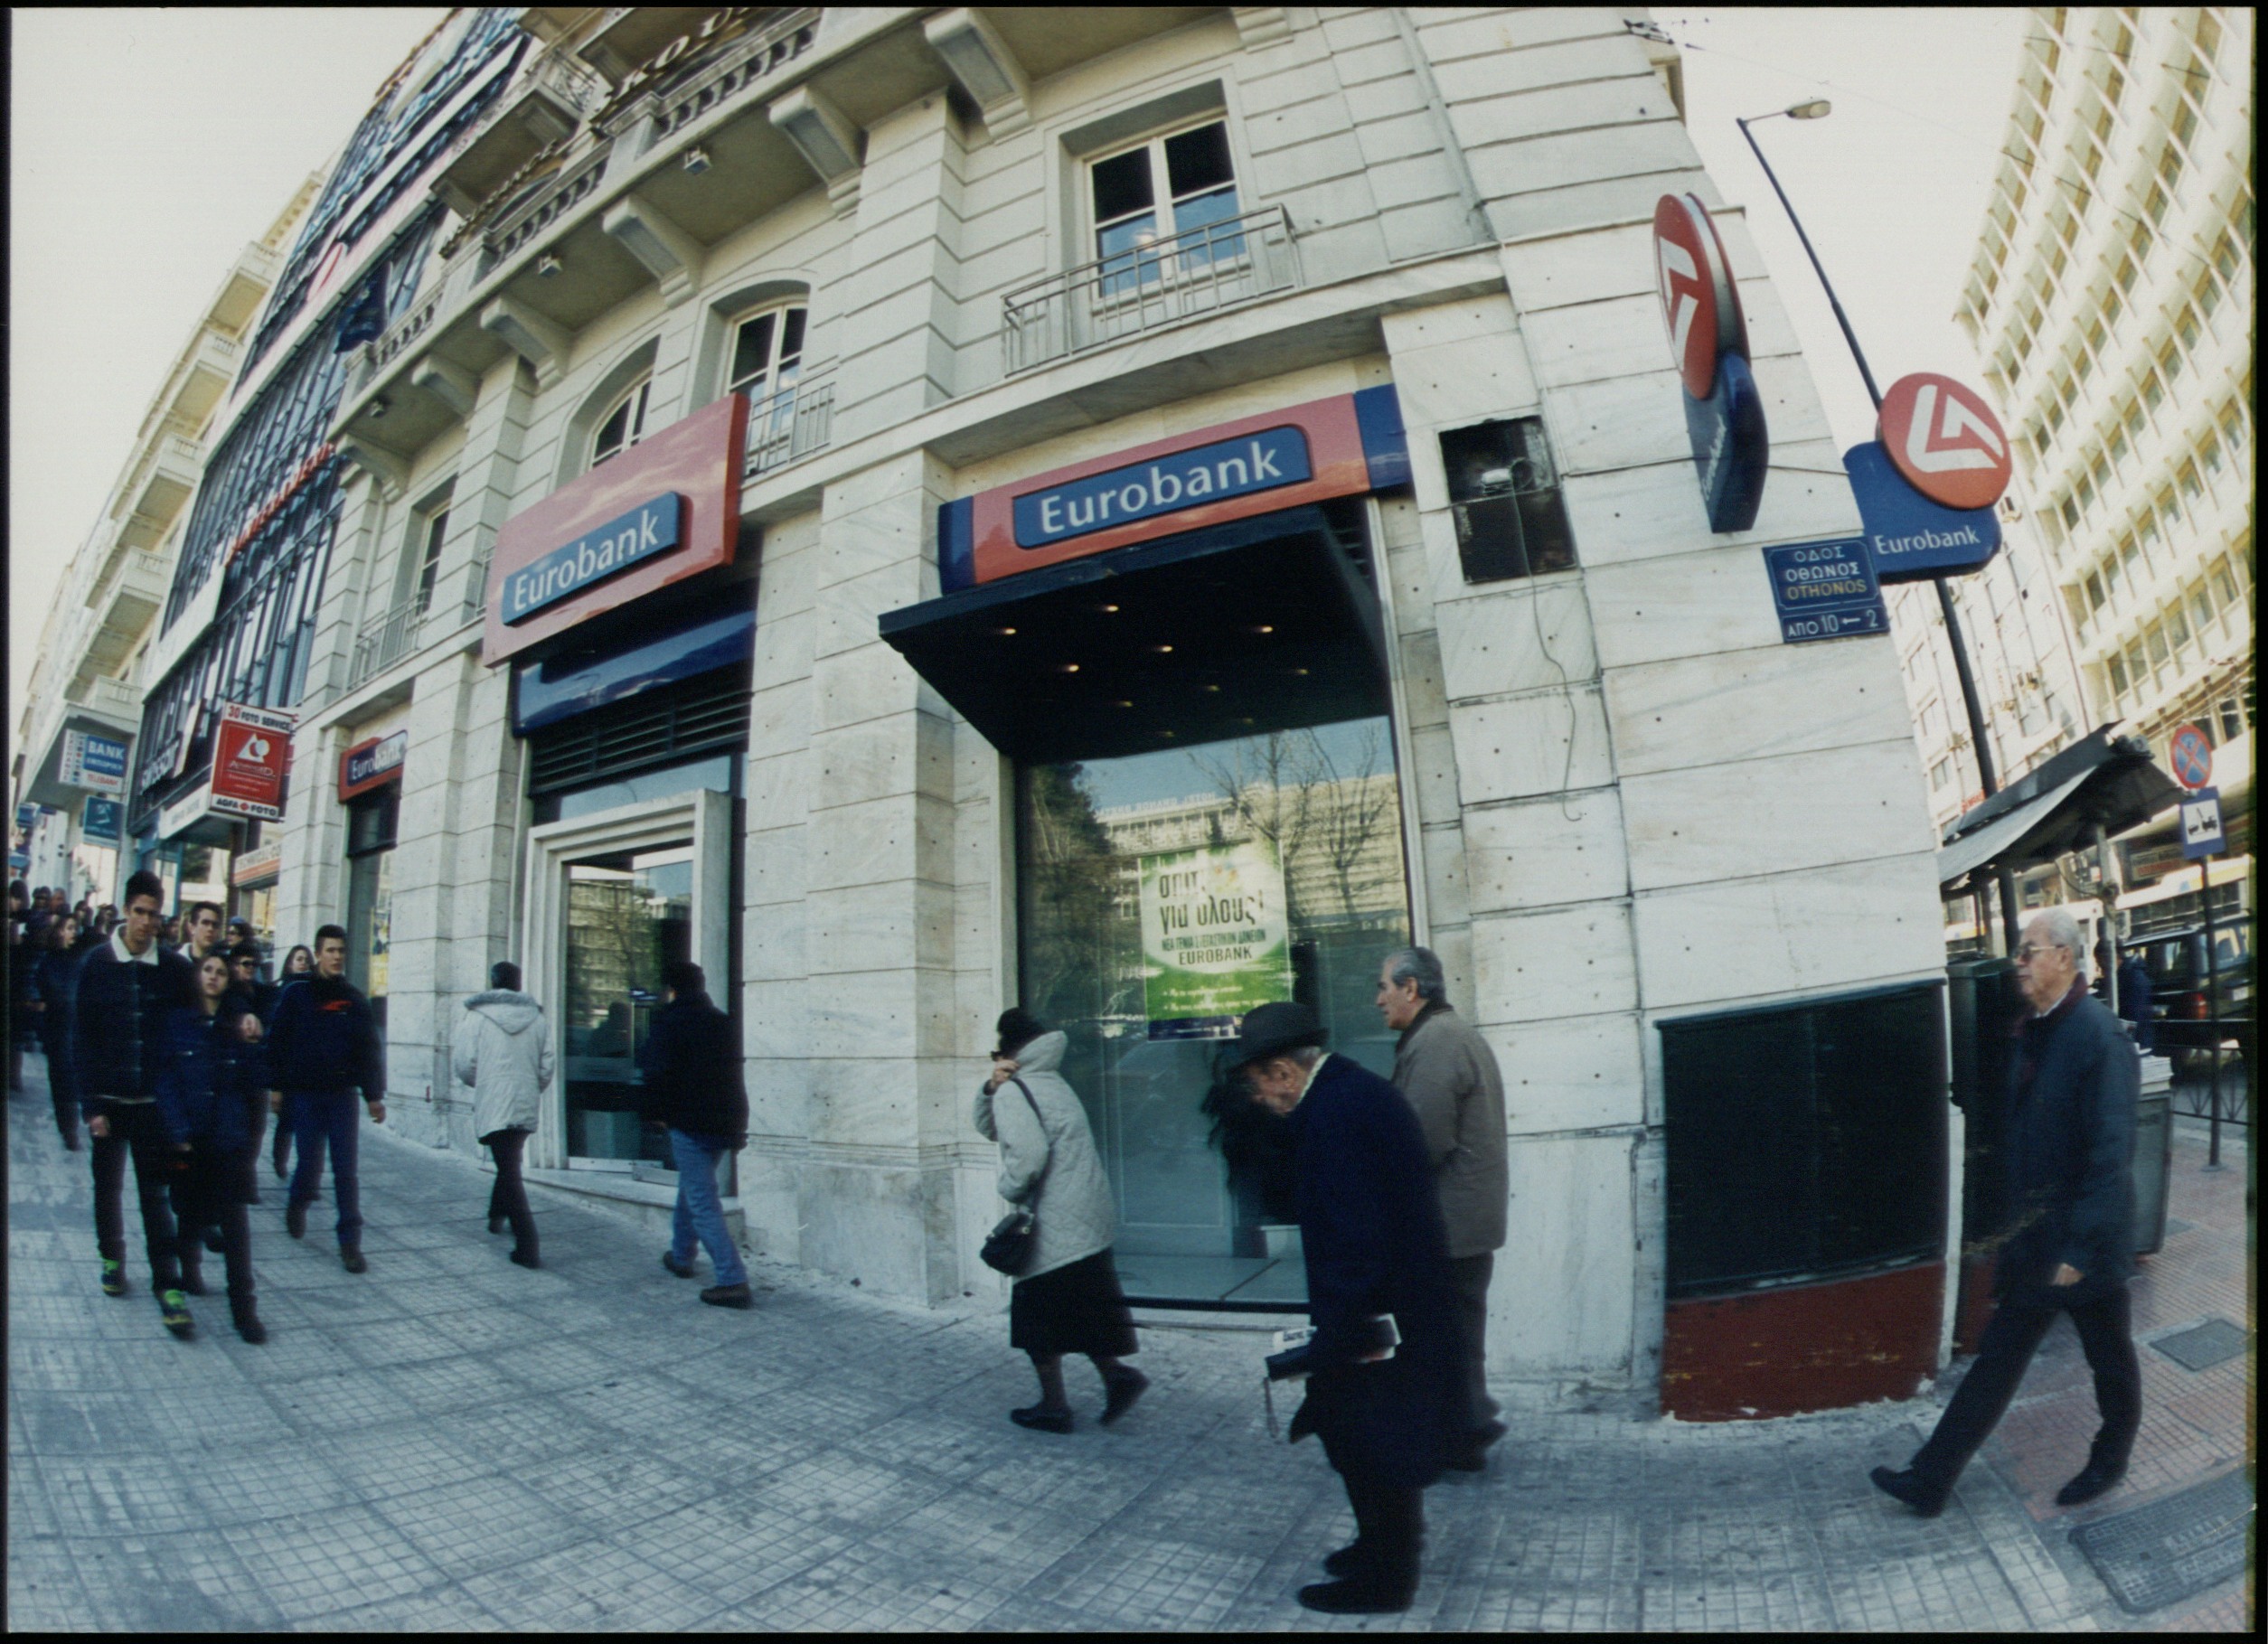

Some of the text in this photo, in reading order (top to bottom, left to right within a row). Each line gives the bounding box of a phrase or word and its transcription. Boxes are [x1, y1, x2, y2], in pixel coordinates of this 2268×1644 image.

[1040, 441, 1283, 535] Eurobank
[1875, 524, 1981, 555] Eurobank
[513, 509, 659, 612] Eurobank
[1793, 546, 1845, 563] ΟΔΟΣ
[1785, 561, 1861, 583] ΟΘΩΝΟΣ
[1786, 579, 1868, 601] OTHONOS
[1787, 609, 1879, 638] ΑΠΟ 10 2
[240, 711, 259, 724] FOTO
[261, 716, 290, 731] SERVICE
[88, 739, 125, 760] BANK
[351, 742, 406, 781] Eurobank
[216, 797, 277, 816] AGFA FOTO
[1179, 945, 1252, 965] EUROBANK
